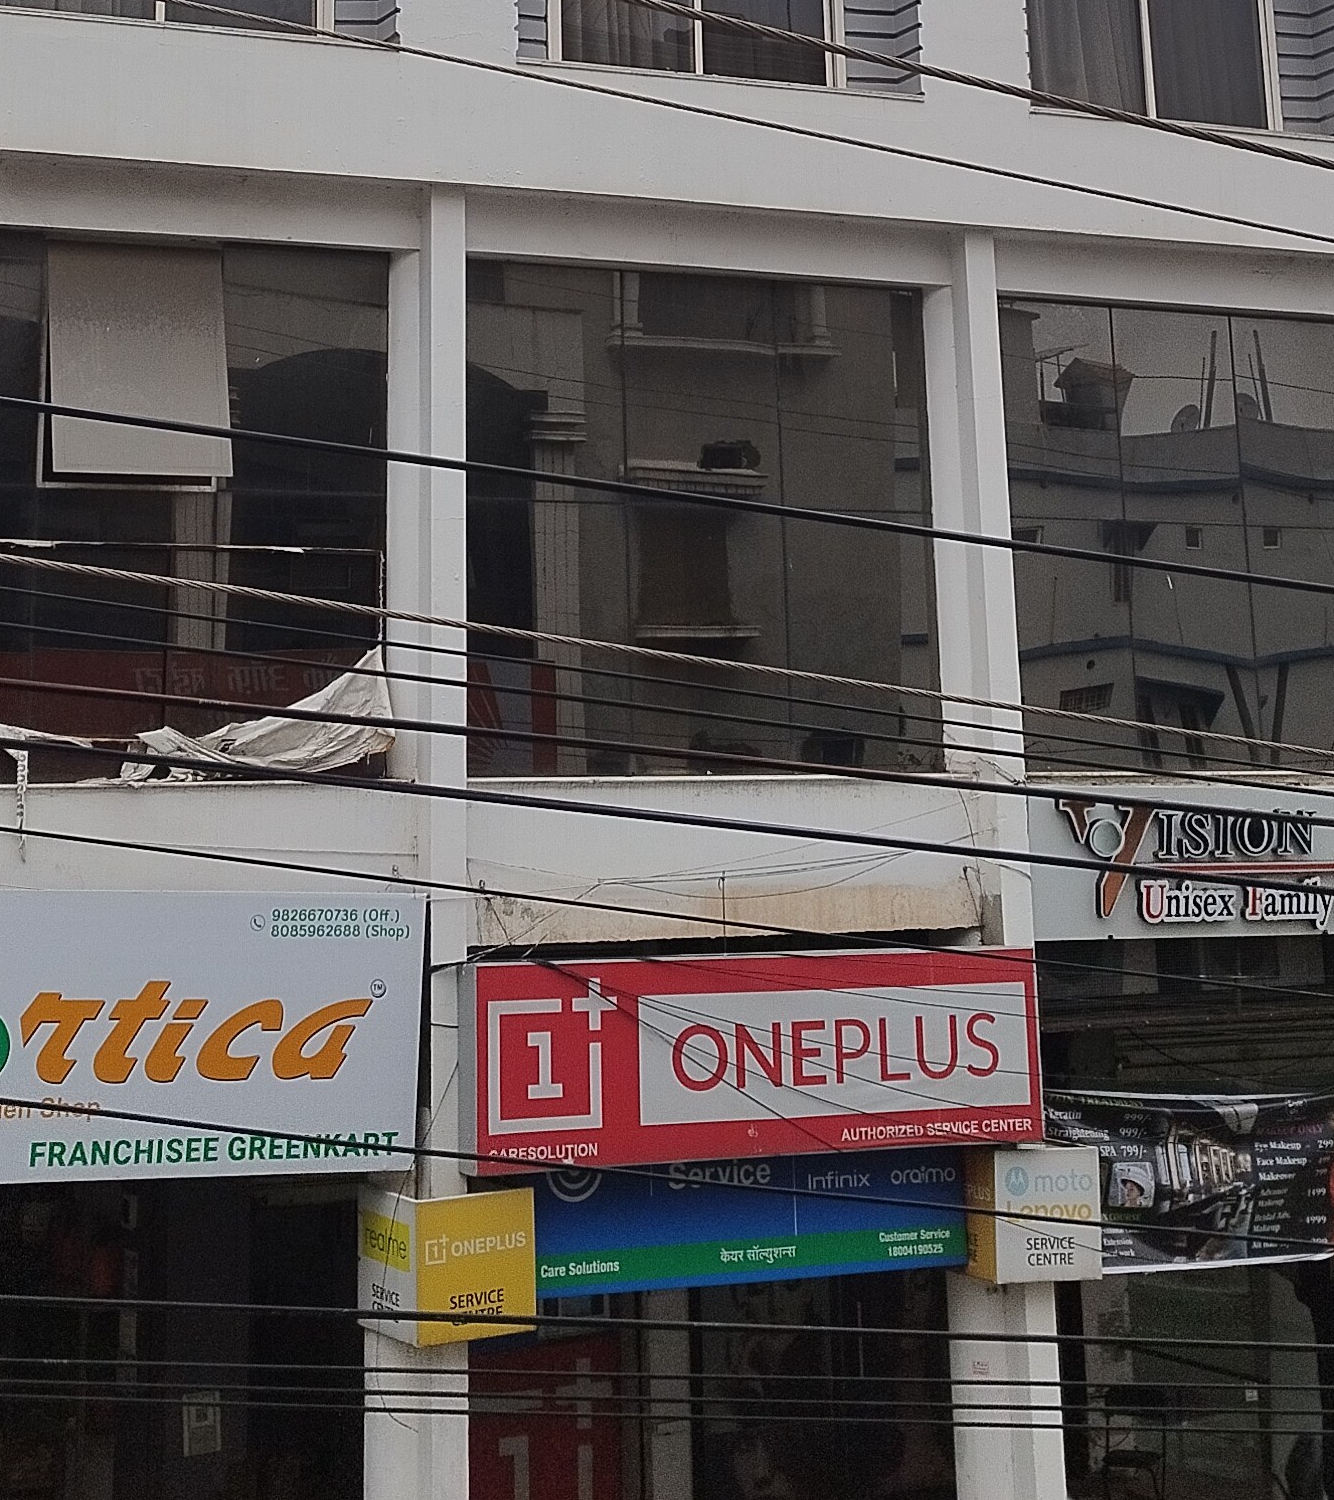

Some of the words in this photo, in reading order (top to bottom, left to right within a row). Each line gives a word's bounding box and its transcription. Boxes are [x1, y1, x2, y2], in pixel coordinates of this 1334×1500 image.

[1141, 880, 1234, 923] Unisex
[1245, 878, 1334, 930] Family
[271, 908, 359, 922] 9826670736
[362, 908, 401, 924] (Off.)
[270, 924, 362, 938] 8085962688
[365, 923, 411, 940] (Shop)
[671, 1011, 1000, 1093] ONEPLUS
[841, 1122, 923, 1143] AUTHORIZED
[925, 1120, 980, 1139] SERVICE
[981, 1117, 1034, 1136] CENTER
[30, 1136, 220, 1168] FRANCHISEE
[227, 1130, 401, 1161] GREENKART
[1099, 1145, 1117, 1157] SPA
[668, 1159, 772, 1189] Service
[807, 1172, 871, 1191] Infinix
[890, 1164, 957, 1186] oraimo
[1034, 1169, 1092, 1192] moto
[365, 1228, 407, 1260] realme
[451, 1231, 527, 1258] ONEPLUS
[879, 1229, 918, 1243] Customer
[919, 1227, 951, 1241] Service
[1026, 1236, 1075, 1250] SERVICE
[540, 1263, 566, 1279] Care
[568, 1258, 620, 1276] Solutions
[1028, 1252, 1074, 1266] CENTRE
[449, 1288, 505, 1310] SERVICE
